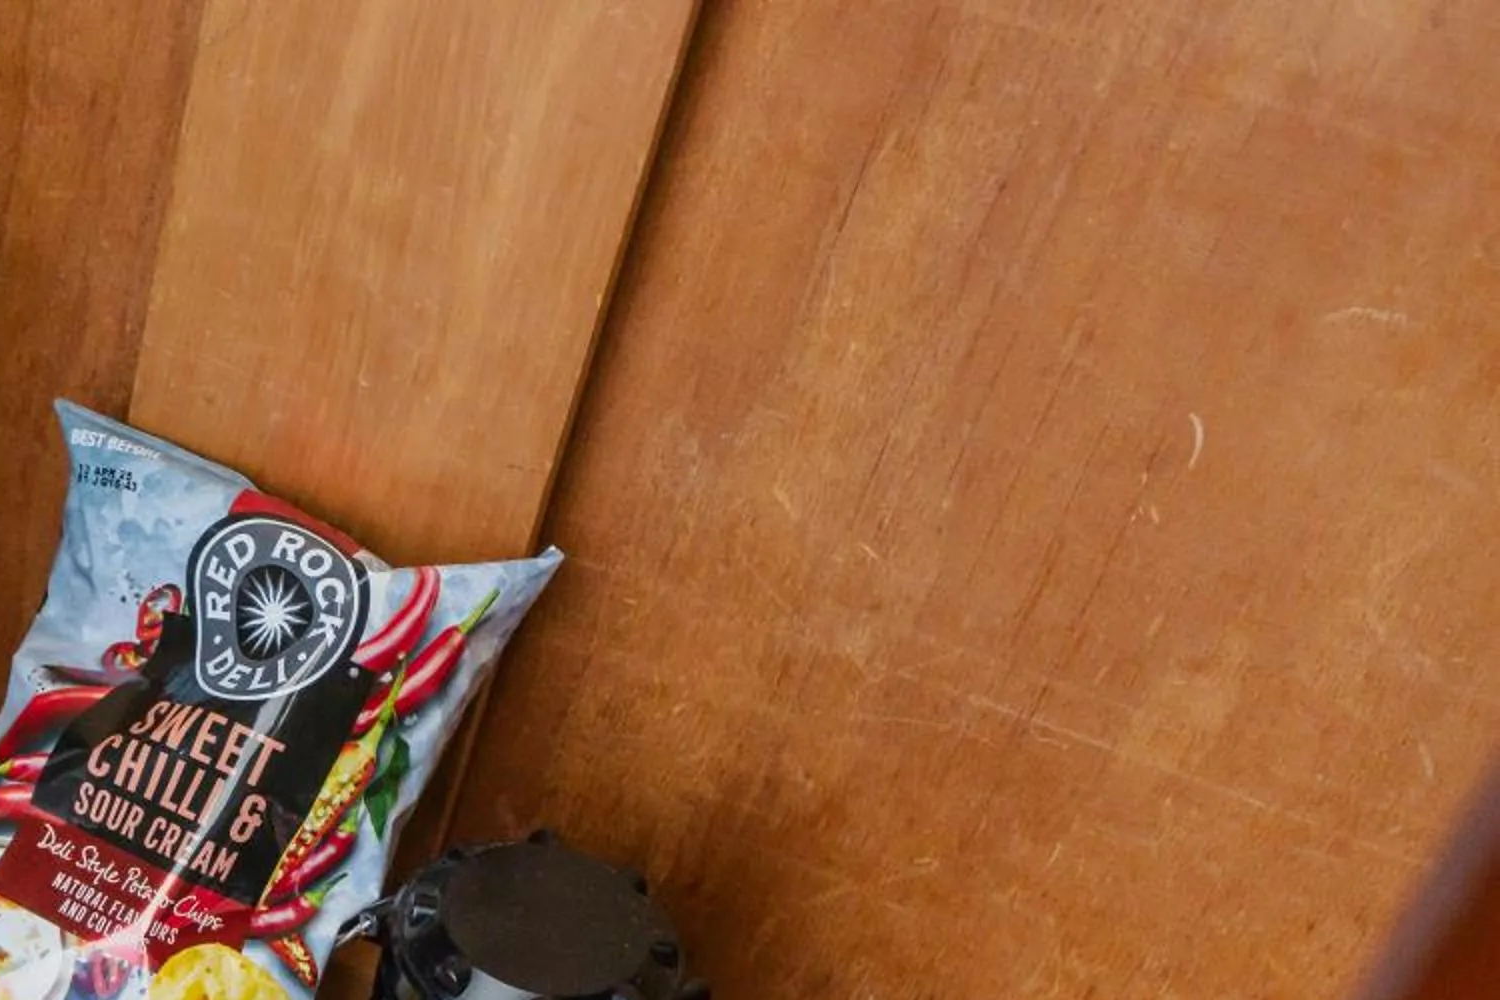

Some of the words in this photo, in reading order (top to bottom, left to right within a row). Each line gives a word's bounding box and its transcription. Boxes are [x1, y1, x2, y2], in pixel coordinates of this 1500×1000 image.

[71, 428, 107, 448] BEST
[205, 533, 256, 622] RED
[271, 530, 346, 648] ROCK
[206, 647, 288, 691] DELI
[130, 701, 286, 787] SWEET
[86, 734, 227, 824] CHILLI
[229, 794, 267, 844] &
[73, 781, 145, 841] SOUR
[145, 815, 239, 884] CREAM
[37, 823, 76, 861] Deli
[75, 845, 121, 885] Style
[173, 895, 226, 933] Chips
[52, 871, 109, 913] NATURAL
[107, 898, 180, 945] FLAVURS
[58, 898, 88, 922] AND
